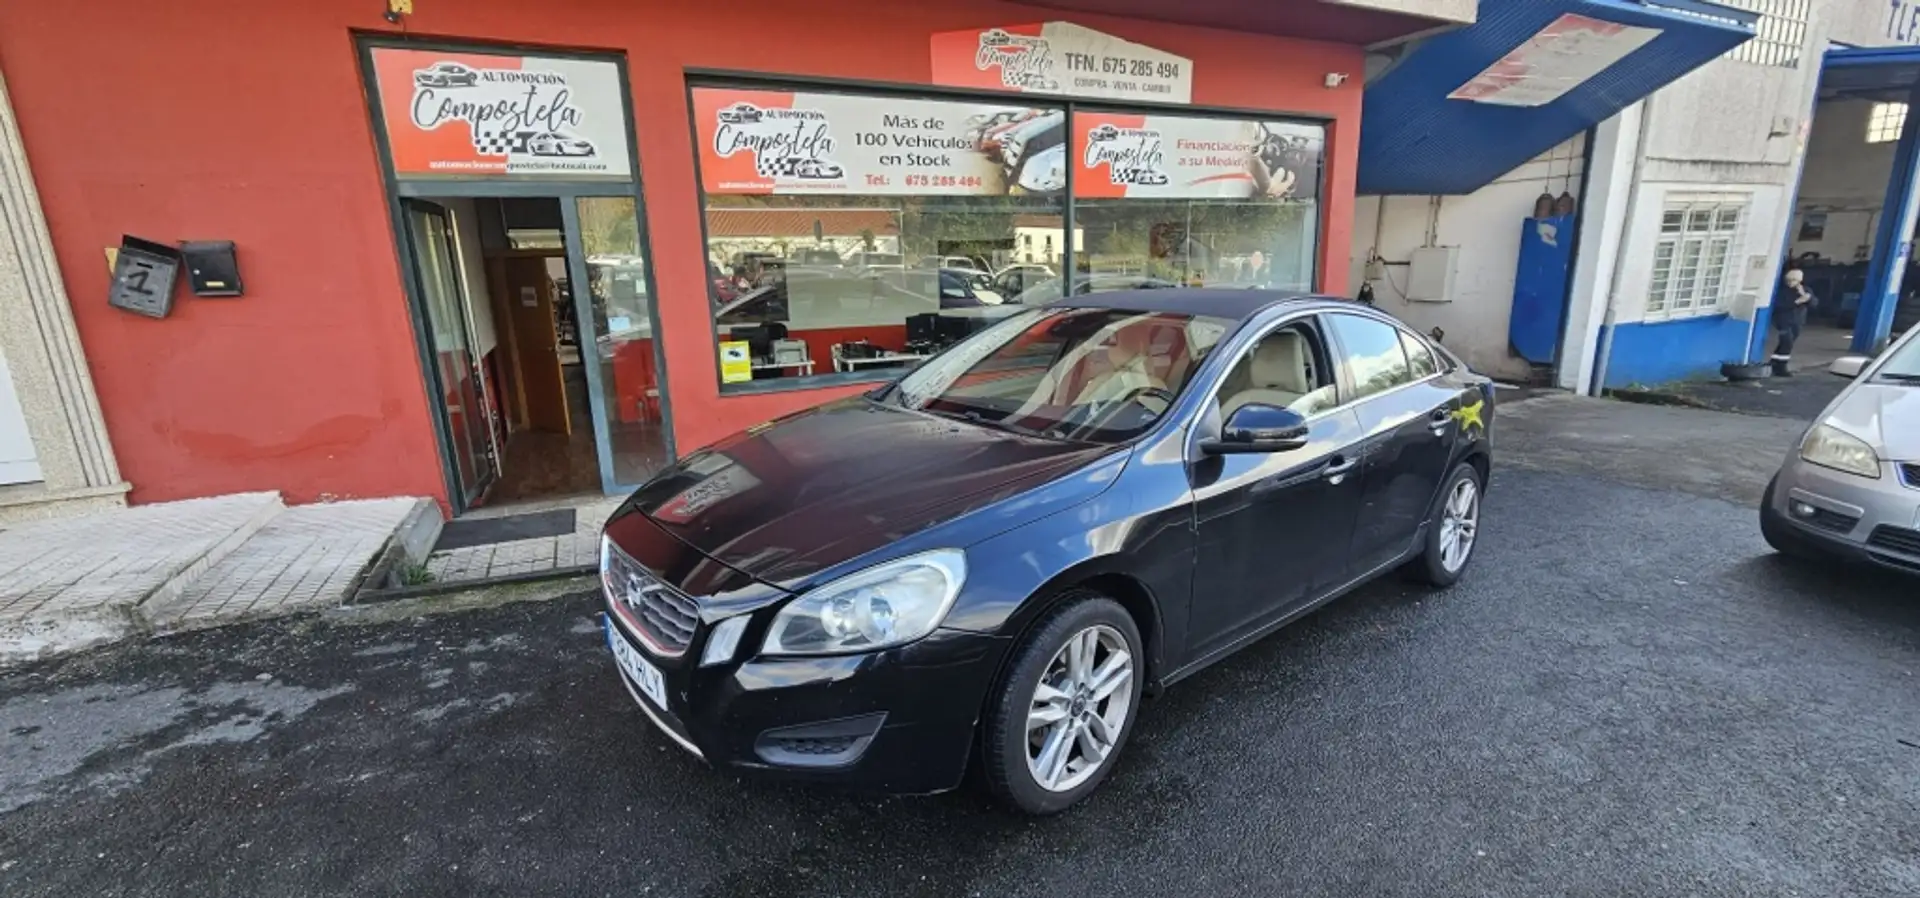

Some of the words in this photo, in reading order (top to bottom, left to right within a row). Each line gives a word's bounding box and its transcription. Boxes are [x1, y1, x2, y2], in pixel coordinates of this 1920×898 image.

[1065, 52, 1098, 72] TFN.
[1102, 57, 1126, 75] 675
[1130, 60, 1153, 77] 285
[1156, 62, 1179, 78] 494
[1074, 77, 1107, 88] COMPRA
[1112, 80, 1137, 91] VENTA
[414, 85, 583, 137] Compostela
[922, 117, 945, 130] de
[716, 120, 835, 167] Compostela
[855, 132, 888, 147] 100
[879, 155, 902, 166] en
[907, 152, 951, 167] Stock
[1086, 138, 1162, 174] Compostela
[1178, 158, 1187, 166] a
[1189, 158, 1203, 166] su
[126, 270, 153, 295] 1
